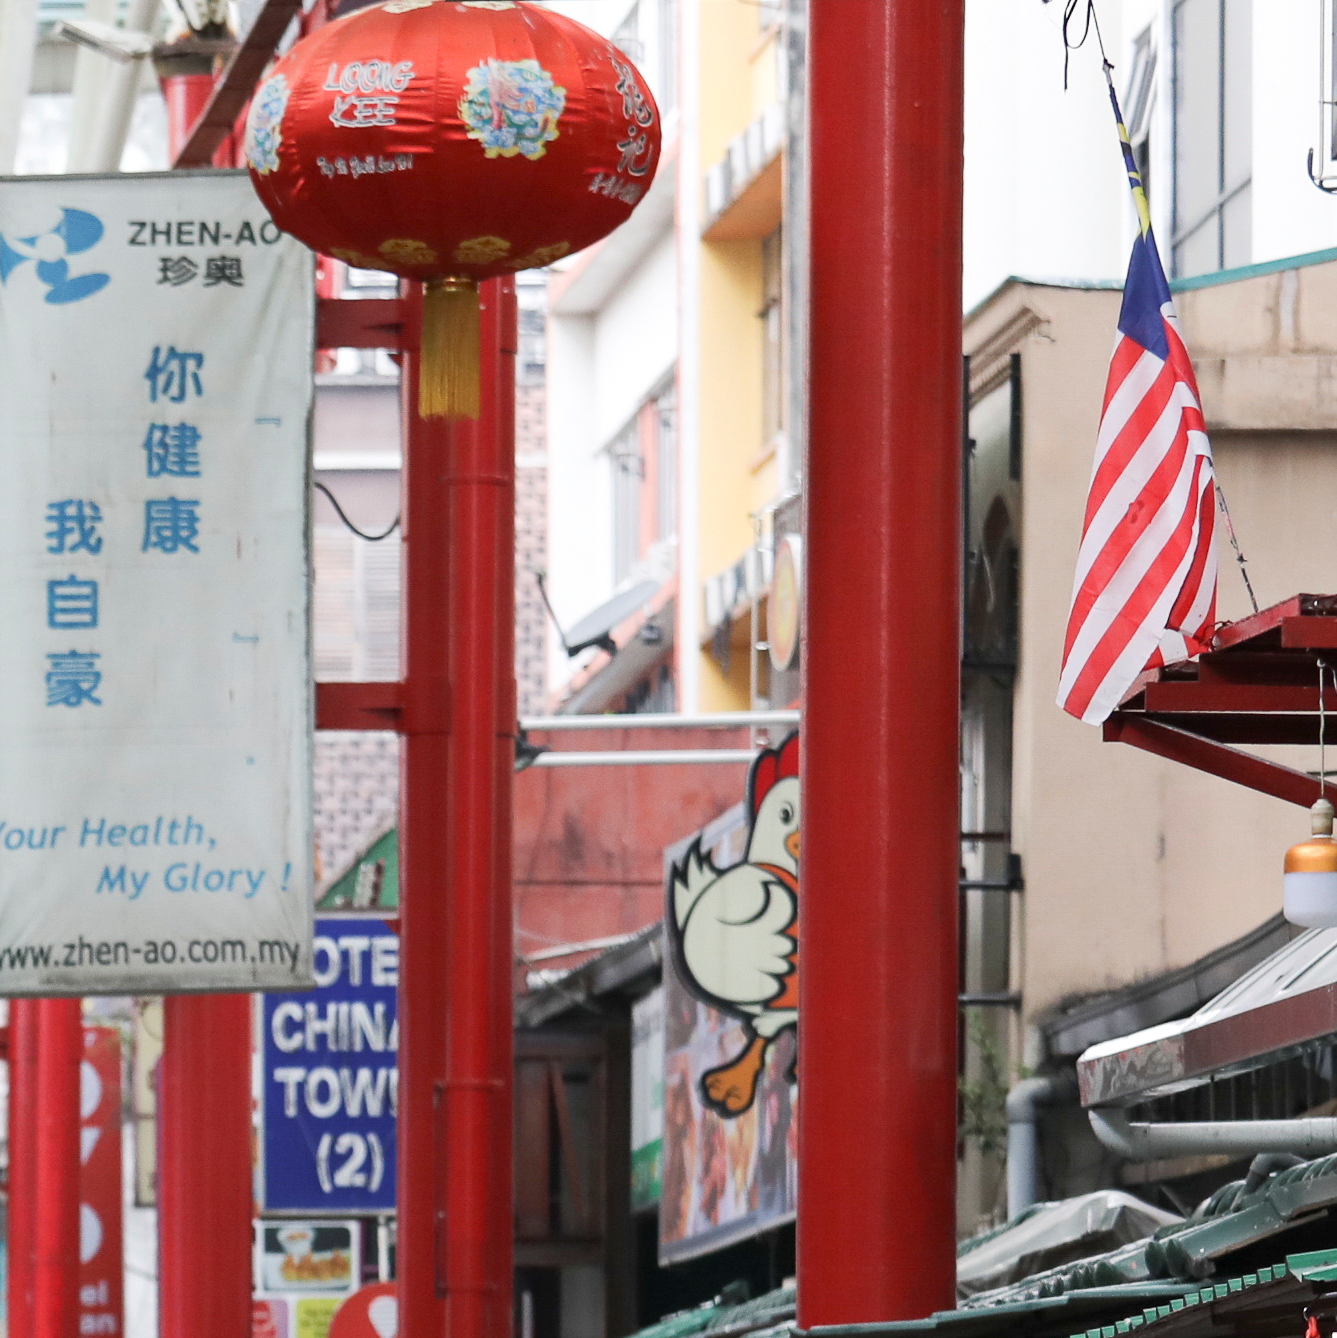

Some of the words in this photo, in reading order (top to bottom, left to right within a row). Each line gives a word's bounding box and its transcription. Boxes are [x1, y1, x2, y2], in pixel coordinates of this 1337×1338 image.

[329, 96, 399, 128] KEE
[127, 219, 282, 247] ZHEN-AO
[140, 346, 204, 555] 你健康
[45, 498, 104, 708] 我自豪
[79, 815, 217, 851] Health,
[96, 864, 150, 900] My
[163, 862, 267, 898] Glory
[280, 862, 293, 892] !
[313, 935, 398, 987] OTE
[316, 1133, 384, 1193] (2)
